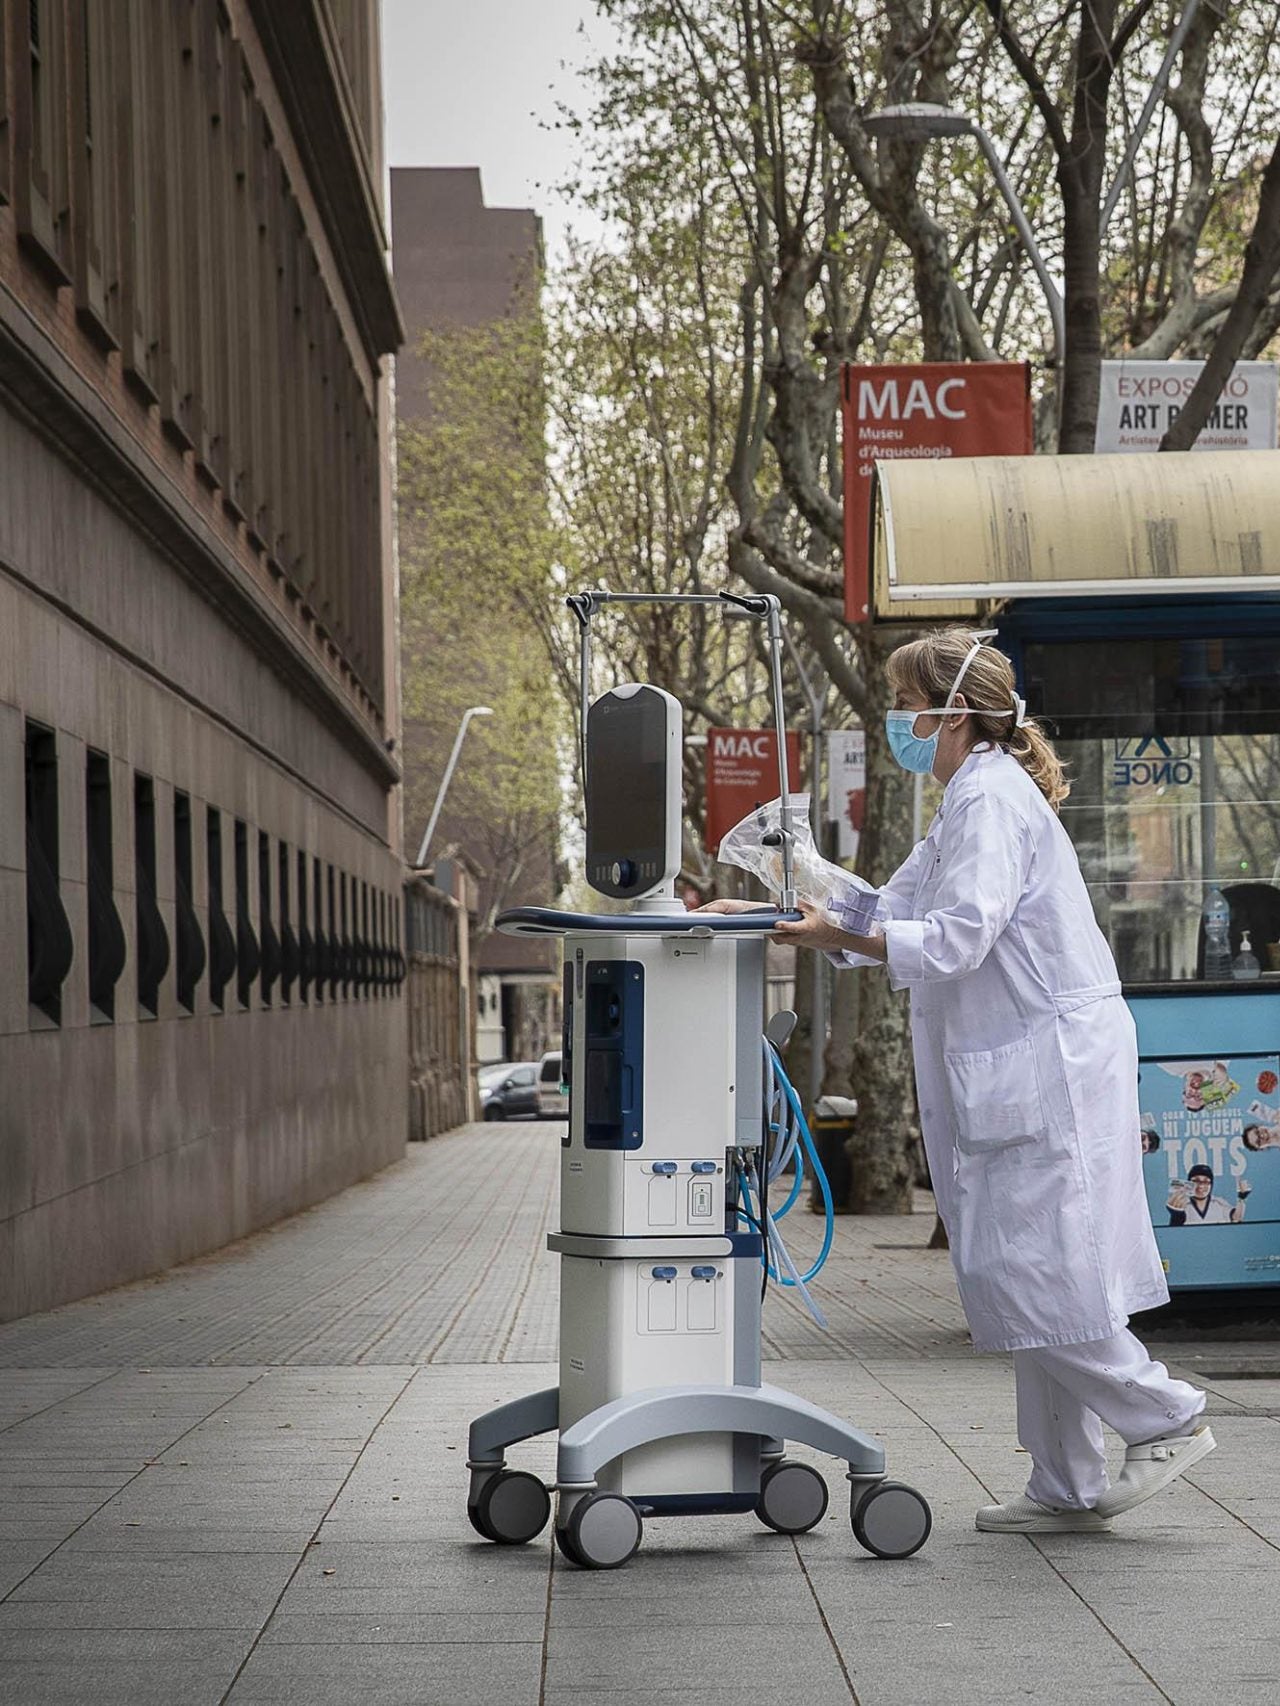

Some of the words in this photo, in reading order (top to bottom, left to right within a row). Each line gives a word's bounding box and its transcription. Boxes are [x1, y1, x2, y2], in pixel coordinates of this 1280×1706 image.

[857, 378, 967, 420] MAC
[1119, 404, 1161, 430] ART
[1167, 404, 1249, 430] PMER
[858, 427, 904, 440] Museu
[858, 445, 953, 460] d'Arqueologia
[713, 736, 770, 759] MAC
[1163, 1121, 1179, 1138] HI
[1184, 1118, 1244, 1138] JUGUEM
[1163, 1135, 1247, 1178] TOTS
